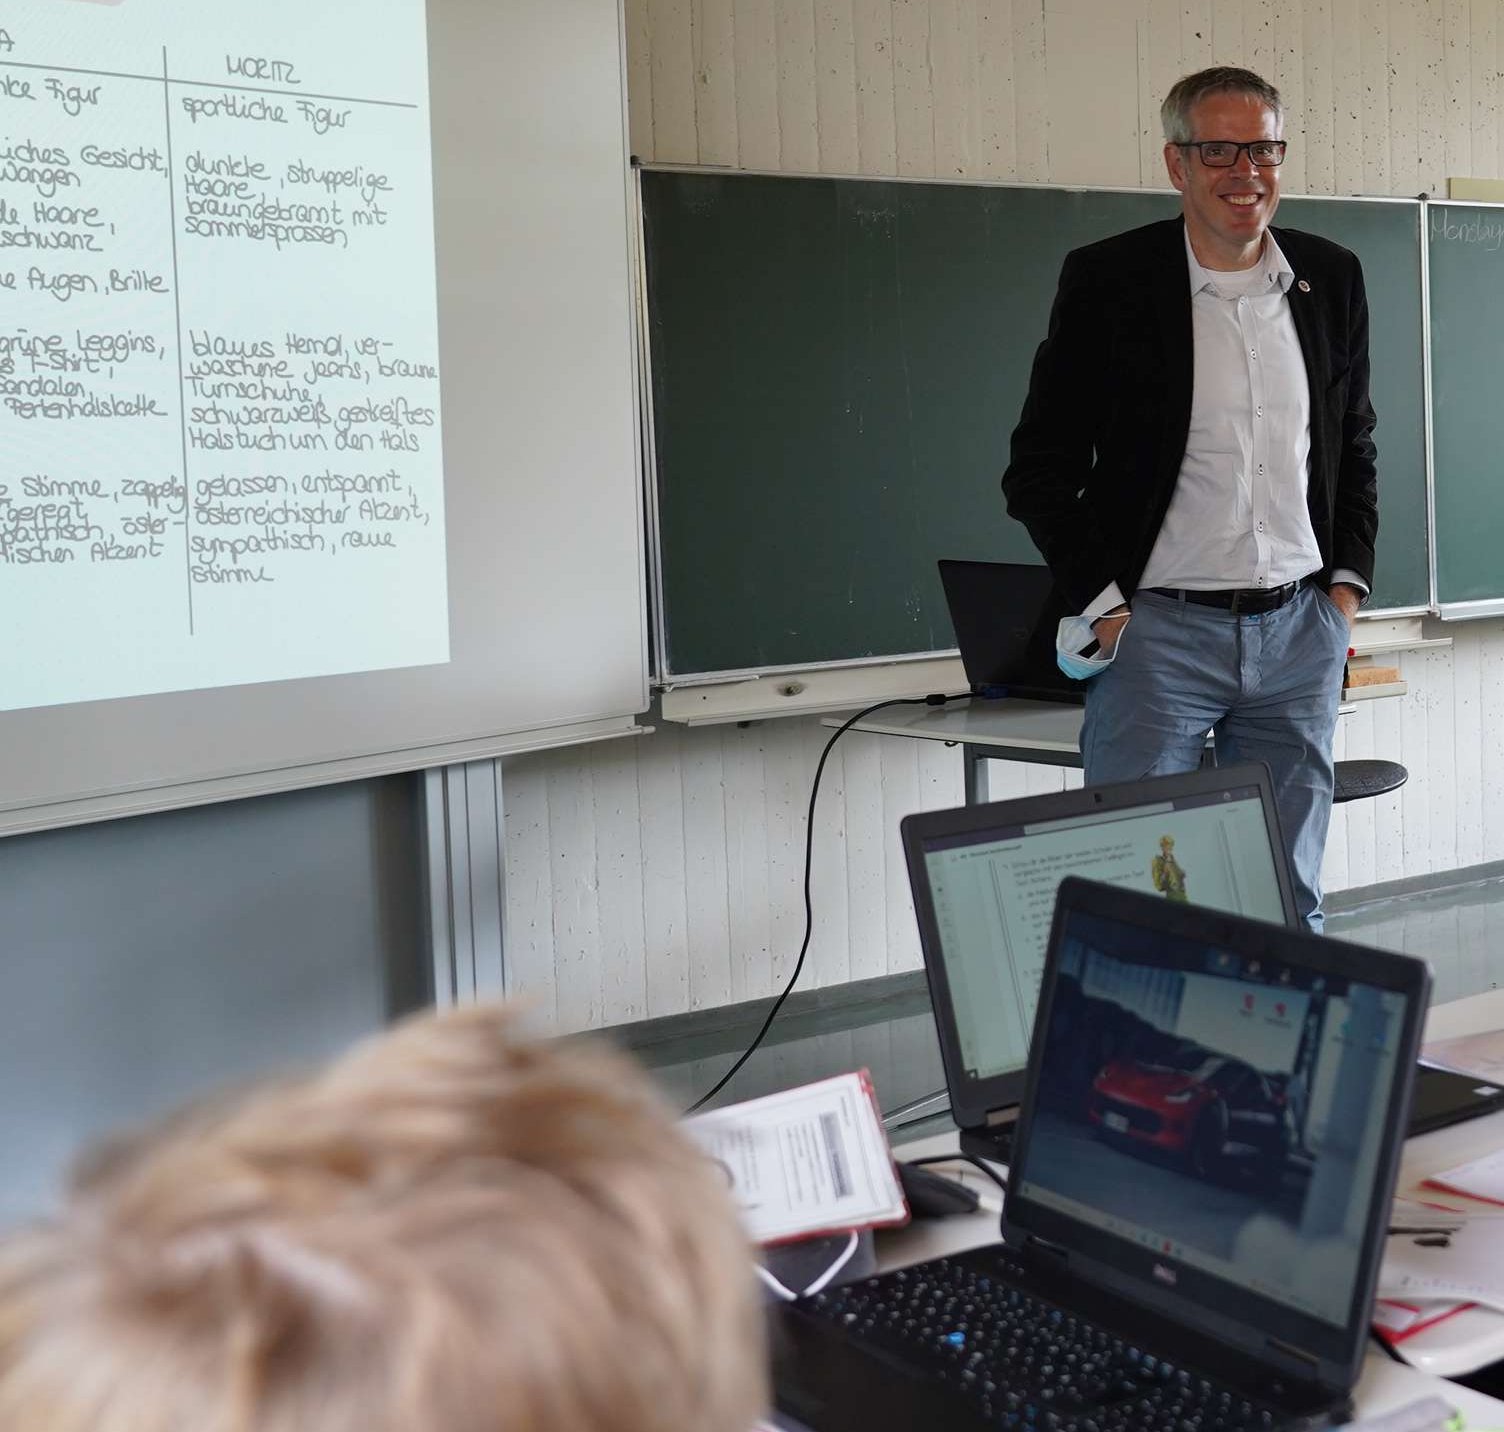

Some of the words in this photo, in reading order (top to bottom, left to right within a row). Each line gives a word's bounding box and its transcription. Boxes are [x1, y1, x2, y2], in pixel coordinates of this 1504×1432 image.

[226, 54, 301, 84] MORITZ
[44, 78, 101, 116] Figur
[182, 93, 288, 124] sportliche
[296, 100, 351, 135] Figur
[0, 136, 70, 167] iches
[352, 202, 388, 226] mit
[189, 330, 276, 358] blaues
[285, 332, 350, 363] Hemd,
[377, 356, 438, 378] braune
[290, 433, 328, 450] um
[335, 428, 374, 450] den
[380, 428, 420, 452] Hals
[341, 530, 396, 548] raue
